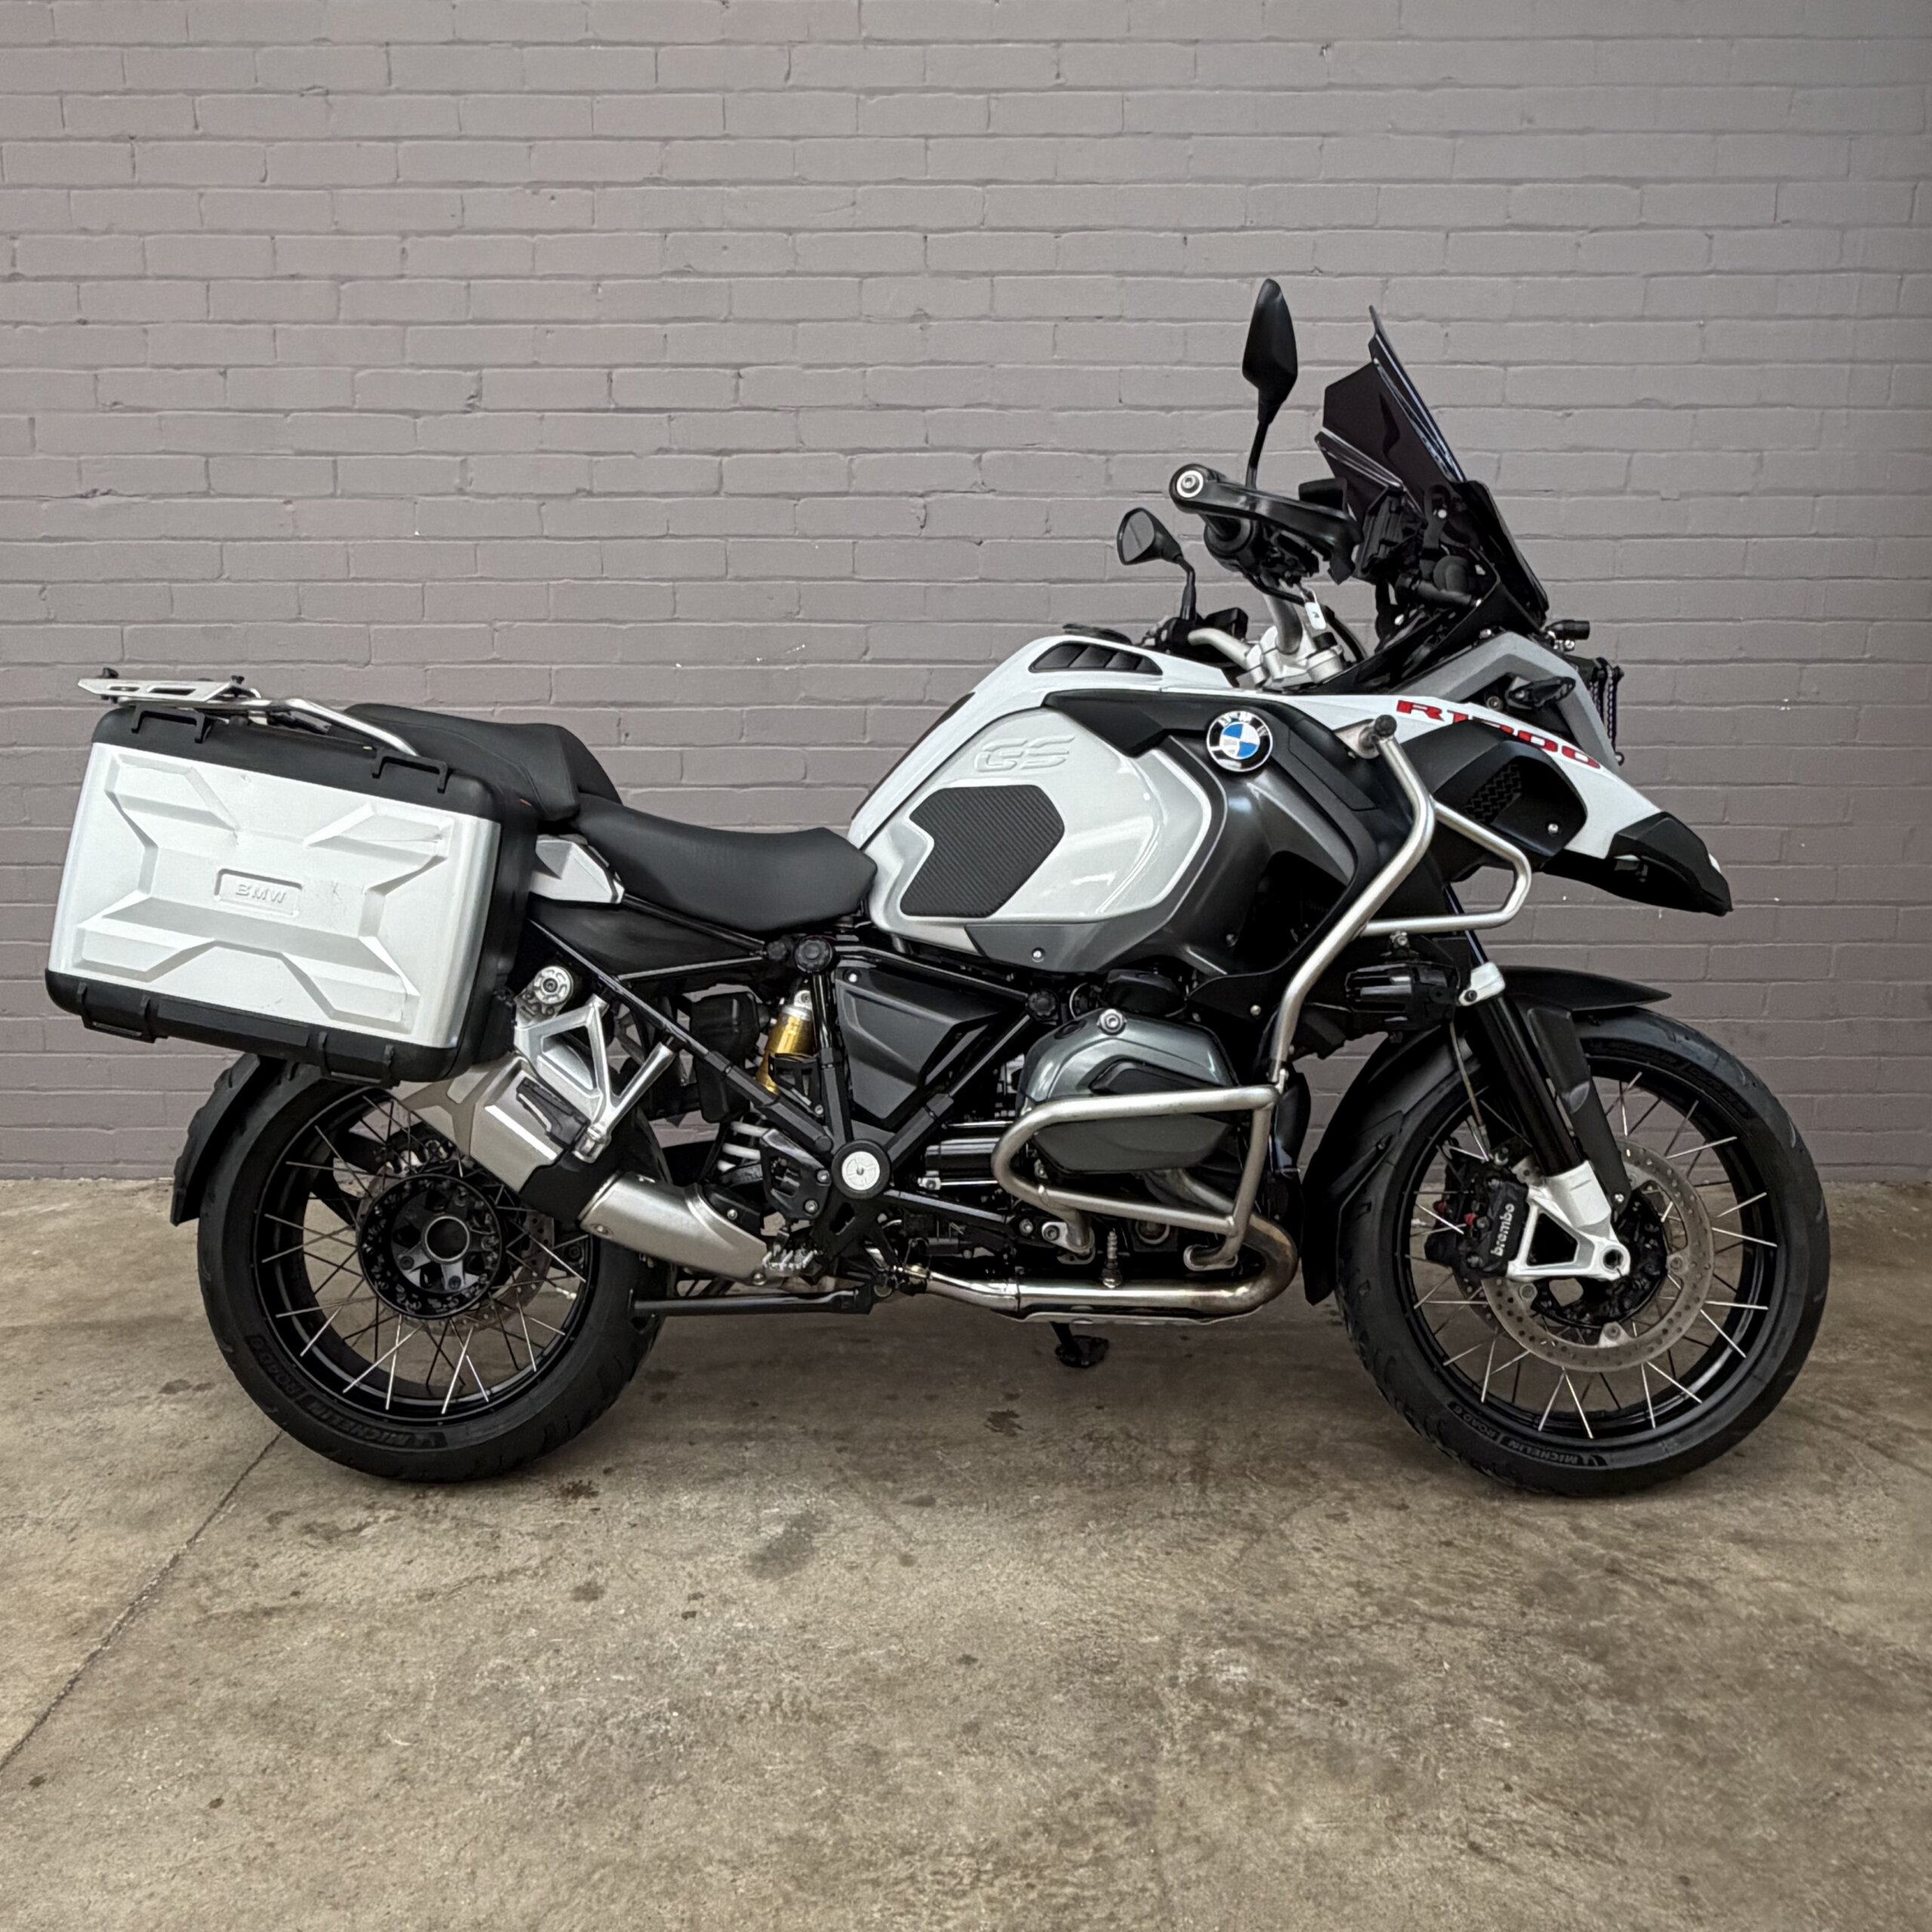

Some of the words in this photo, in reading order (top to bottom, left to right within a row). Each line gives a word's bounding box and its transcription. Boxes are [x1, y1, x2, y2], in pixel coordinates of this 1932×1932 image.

[974, 736, 1075, 773] GS
[235, 883, 286, 904] BMW
[1490, 1203, 1515, 1257] brembo
[1462, 1413, 1497, 1438] ROAD
[1507, 1439, 1578, 1464] MICHELIN
